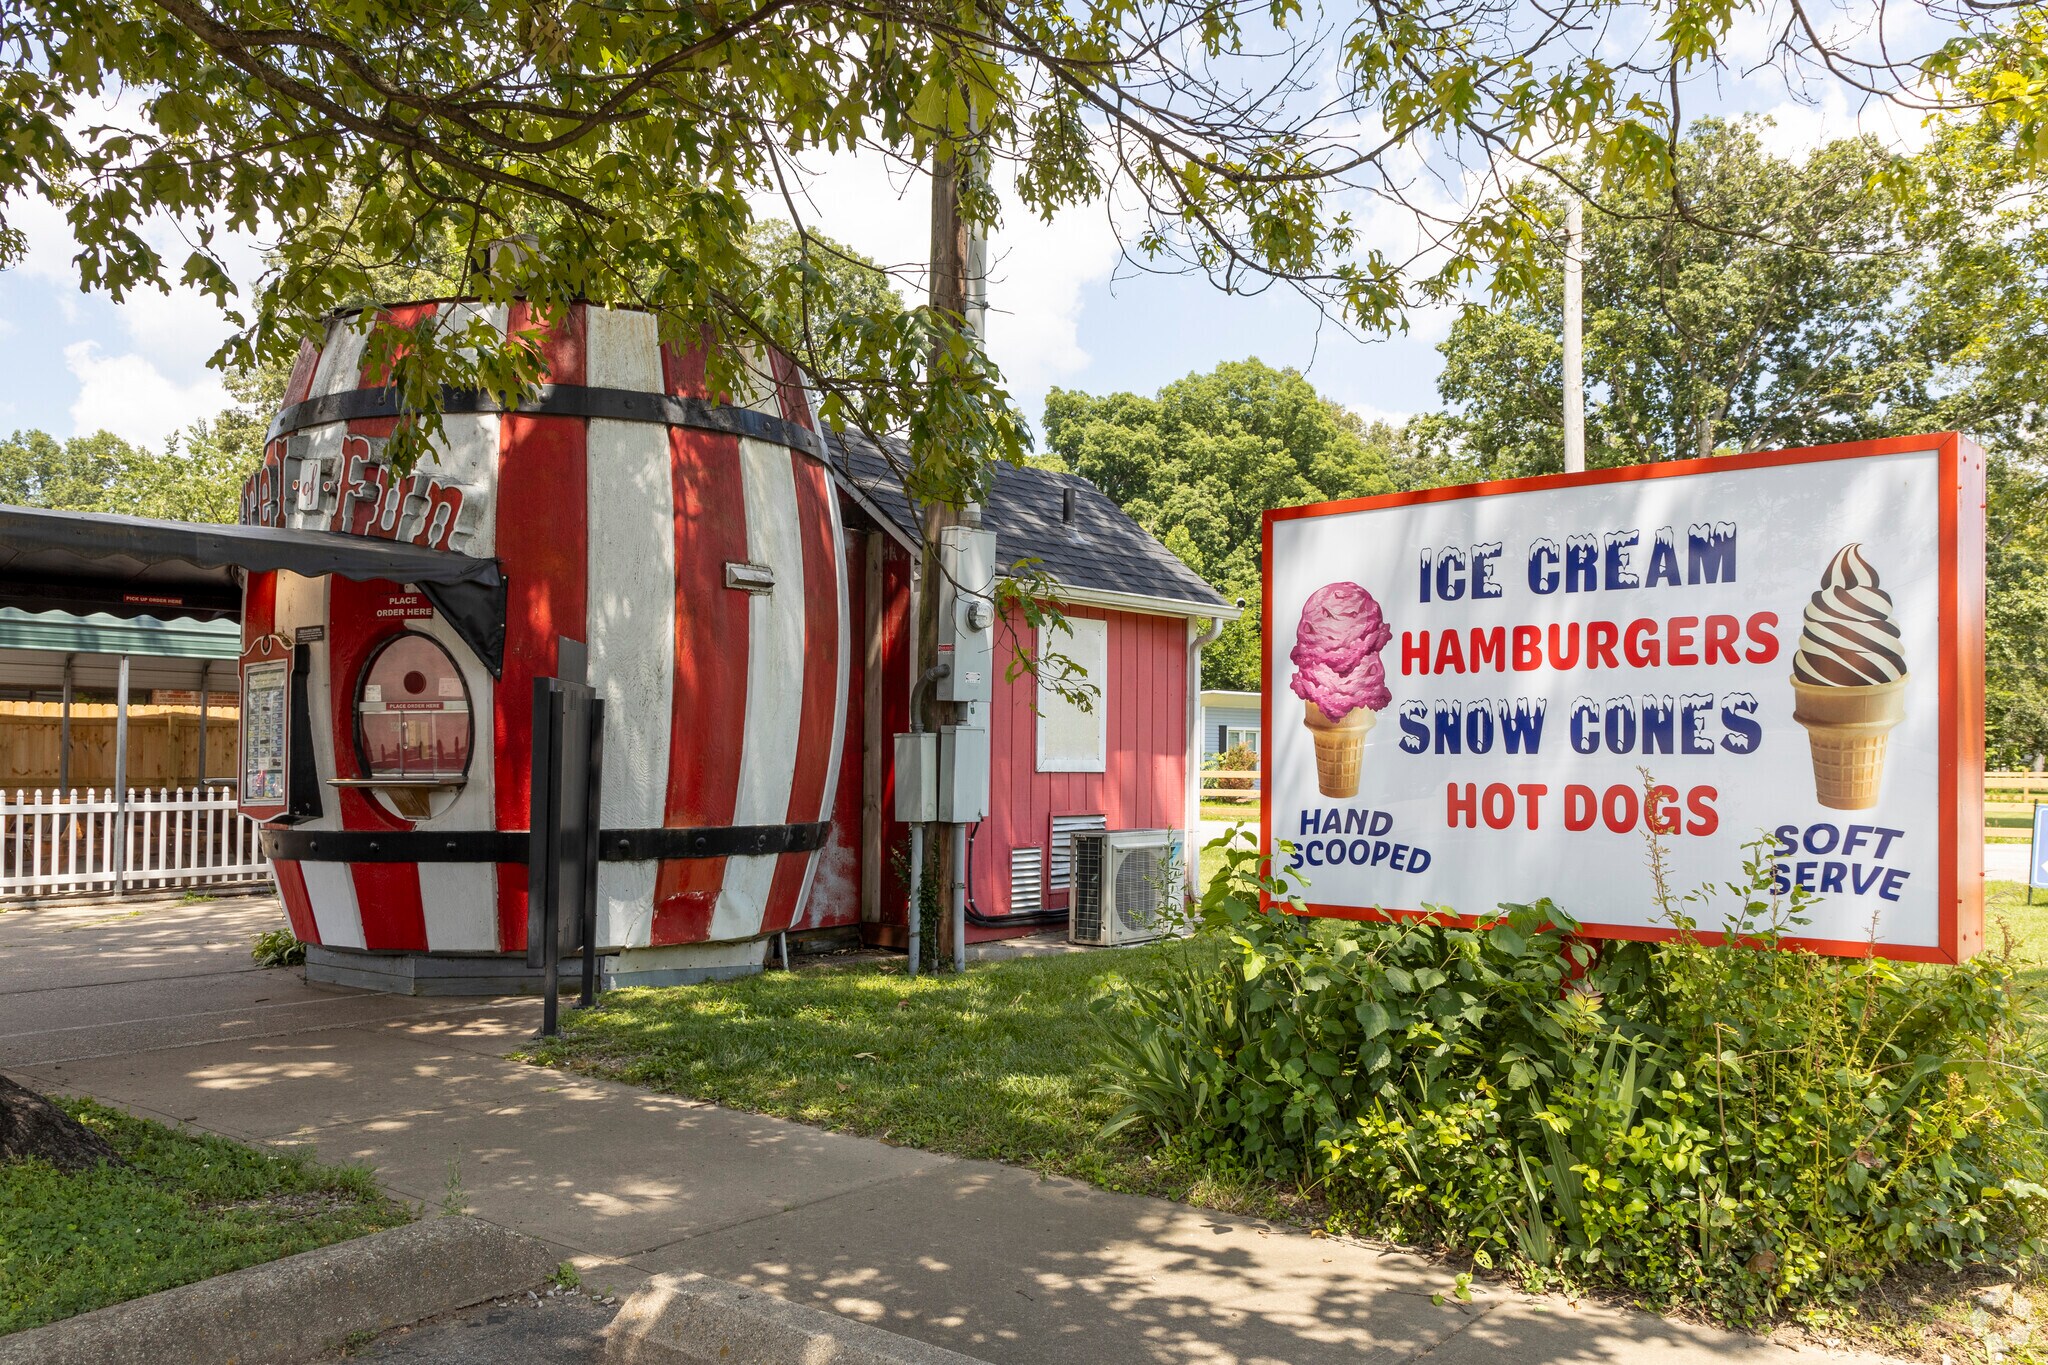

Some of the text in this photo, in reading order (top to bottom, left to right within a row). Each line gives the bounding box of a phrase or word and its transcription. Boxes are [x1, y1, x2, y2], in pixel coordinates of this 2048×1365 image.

[302, 463, 317, 506] of
[330, 436, 464, 551] Fun
[1419, 521, 1737, 603] ICE CREAM
[376, 607, 432, 617] ORDER HERE
[389, 597, 417, 605] PLACE
[1401, 611, 1780, 676] HAMBURGERS
[1398, 692, 1763, 755] SNOW CONES
[1300, 808, 1394, 837] HAND
[1446, 782, 1720, 837] HOT DOGS
[1289, 838, 1432, 874] SCOOPED
[1773, 823, 1905, 860] SOFT
[1769, 861, 1911, 902] SERVE
